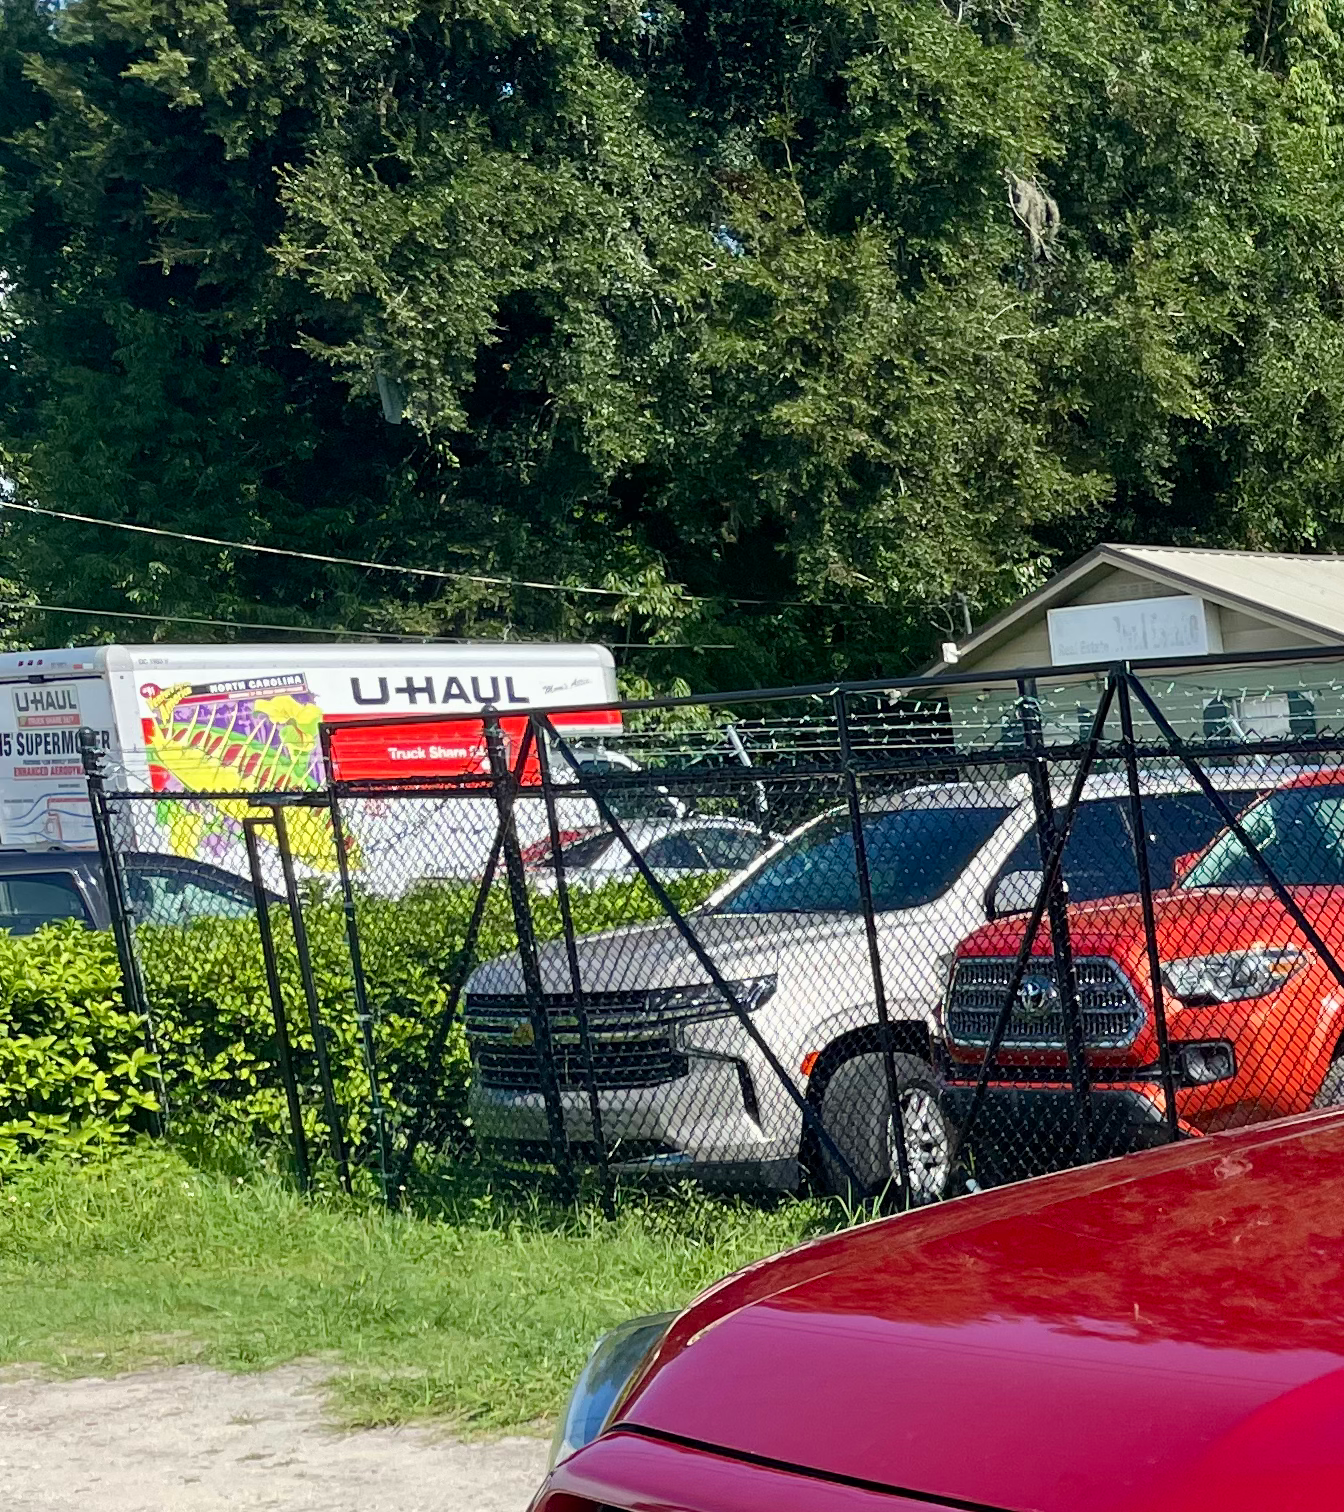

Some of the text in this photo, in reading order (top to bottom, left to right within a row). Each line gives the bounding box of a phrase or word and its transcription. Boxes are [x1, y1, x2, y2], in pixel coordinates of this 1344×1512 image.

[209, 681, 246, 694] NORTH
[248, 675, 302, 689] CAROLINA
[350, 676, 530, 705] U-HAUL
[15, 690, 77, 712] U-HAUL
[387, 747, 426, 760] Truck
